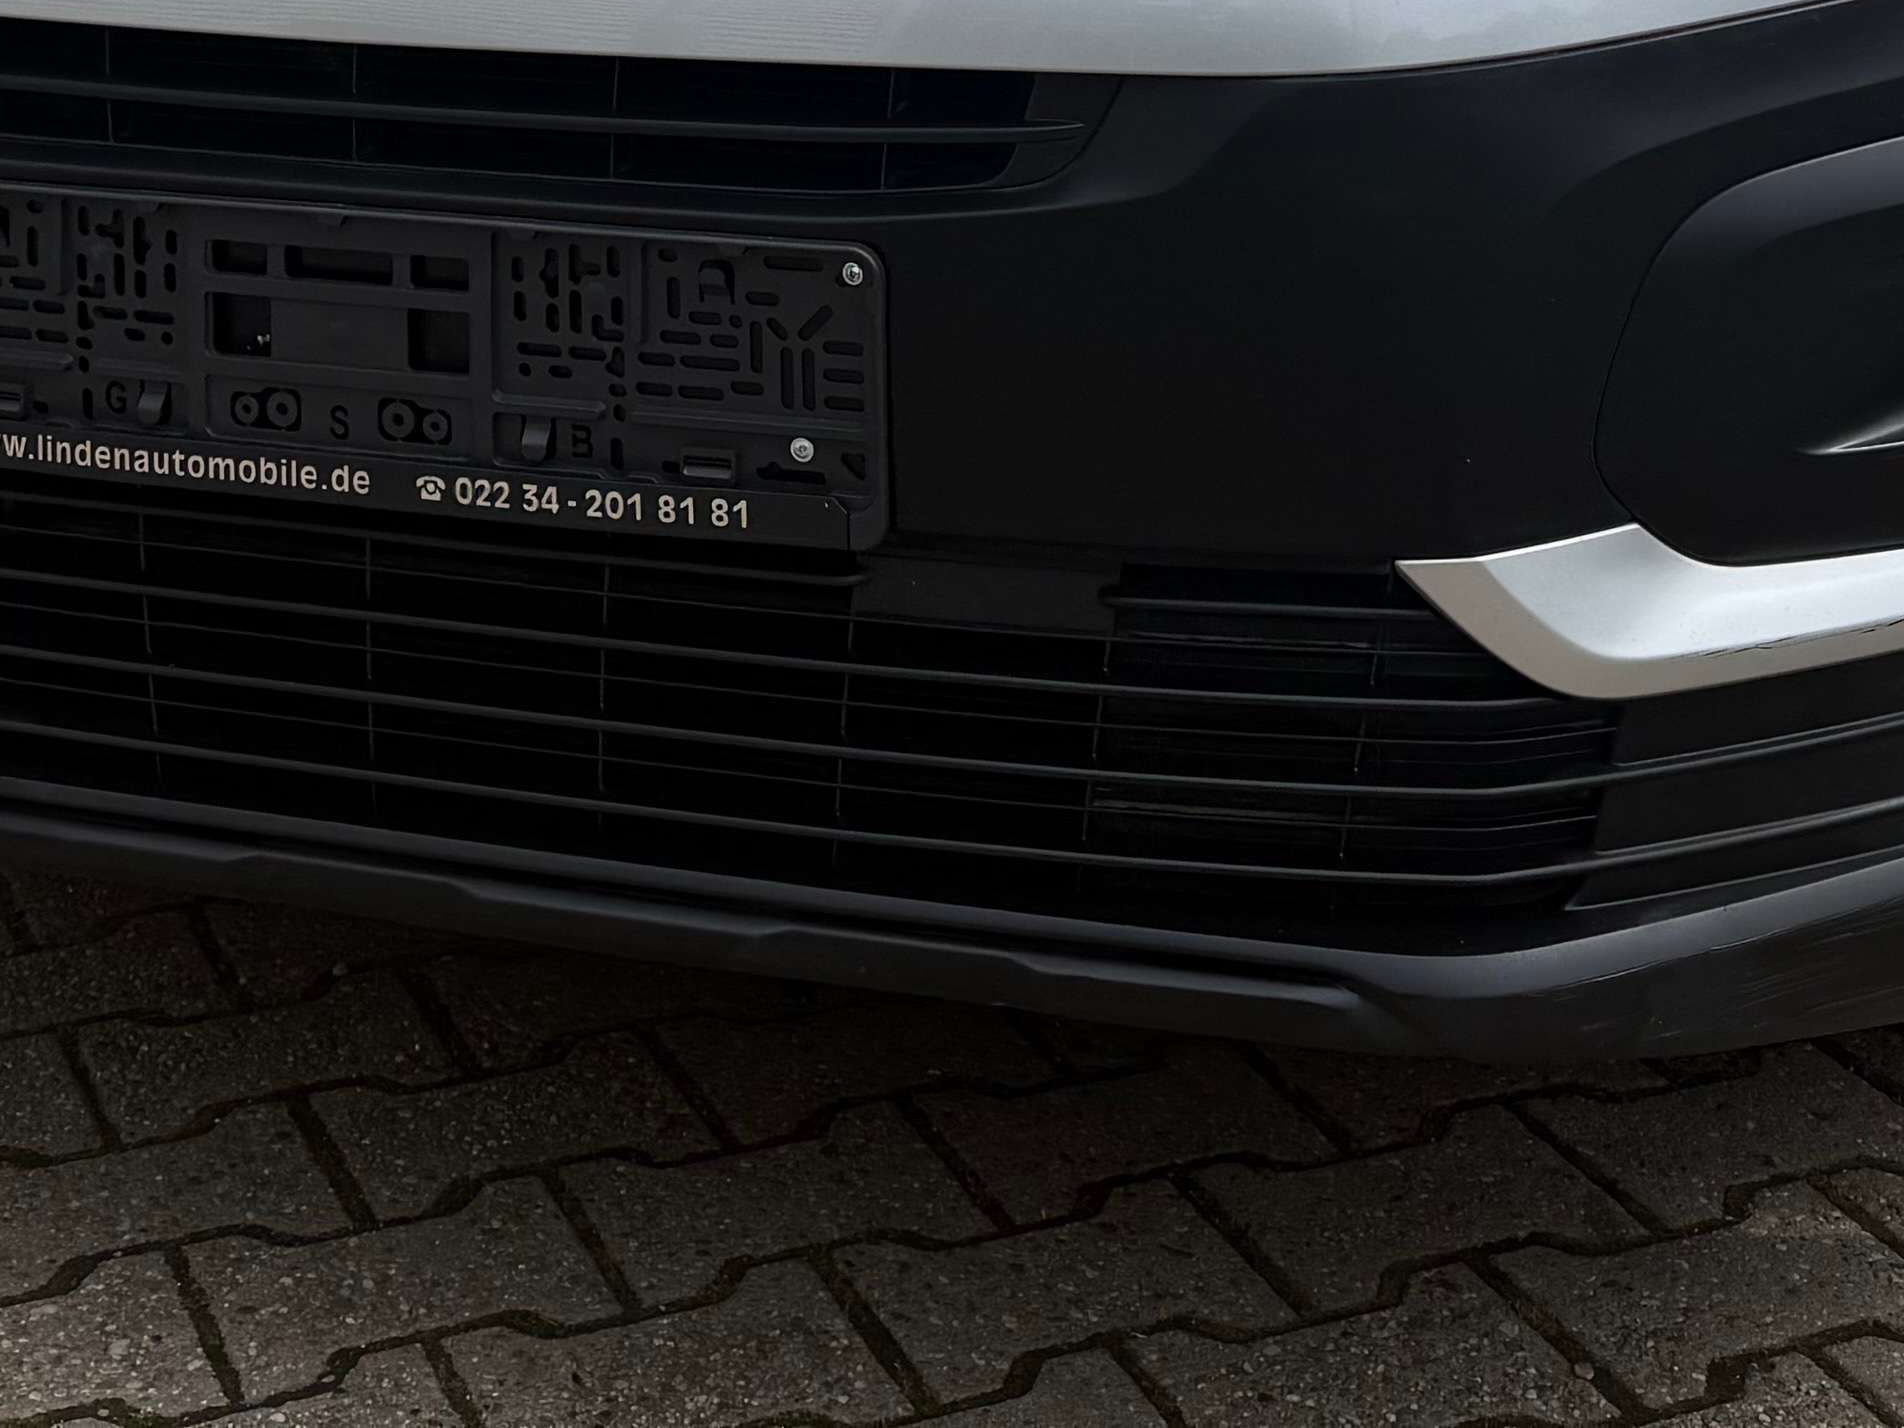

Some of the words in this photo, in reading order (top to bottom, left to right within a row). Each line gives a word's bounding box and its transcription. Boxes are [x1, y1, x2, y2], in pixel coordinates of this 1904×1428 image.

[454, 476, 511, 509] 022
[657, 494, 696, 525] 81
[710, 497, 748, 529] 81
